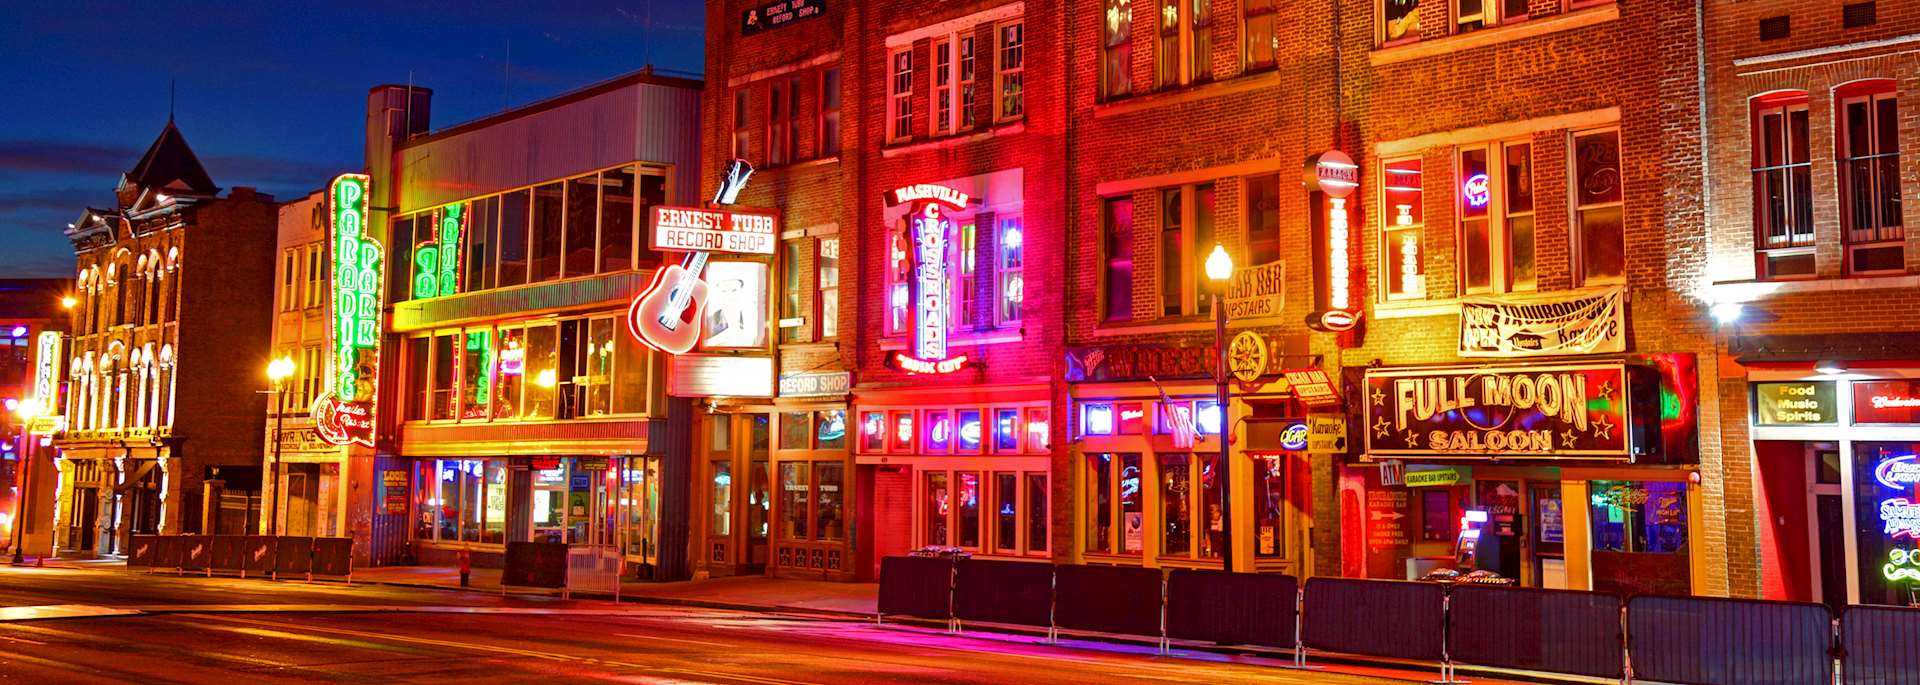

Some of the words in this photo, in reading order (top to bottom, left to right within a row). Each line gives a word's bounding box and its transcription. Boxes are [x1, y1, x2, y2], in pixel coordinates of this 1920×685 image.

[895, 184, 969, 208] NASHVILLE
[658, 208, 724, 230] ERNEST
[731, 214, 774, 232] TUBB
[666, 230, 723, 249] RECORD
[729, 235, 765, 251] SHOP
[338, 180, 360, 402] PARADISE
[925, 203, 940, 360] CROSSROADS
[1257, 264, 1281, 296] BAR
[357, 243, 378, 347] PARK
[780, 376, 817, 393] RECORD
[820, 375, 847, 391] SHOP
[1779, 385, 1816, 396] Food
[1394, 375, 1476, 431] FULL
[1482, 372, 1589, 432] MOON
[1777, 398, 1819, 410] Music
[1776, 411, 1821, 423] Spirits
[1429, 429, 1553, 453] SALOON
[1383, 464, 1404, 485] ATM
